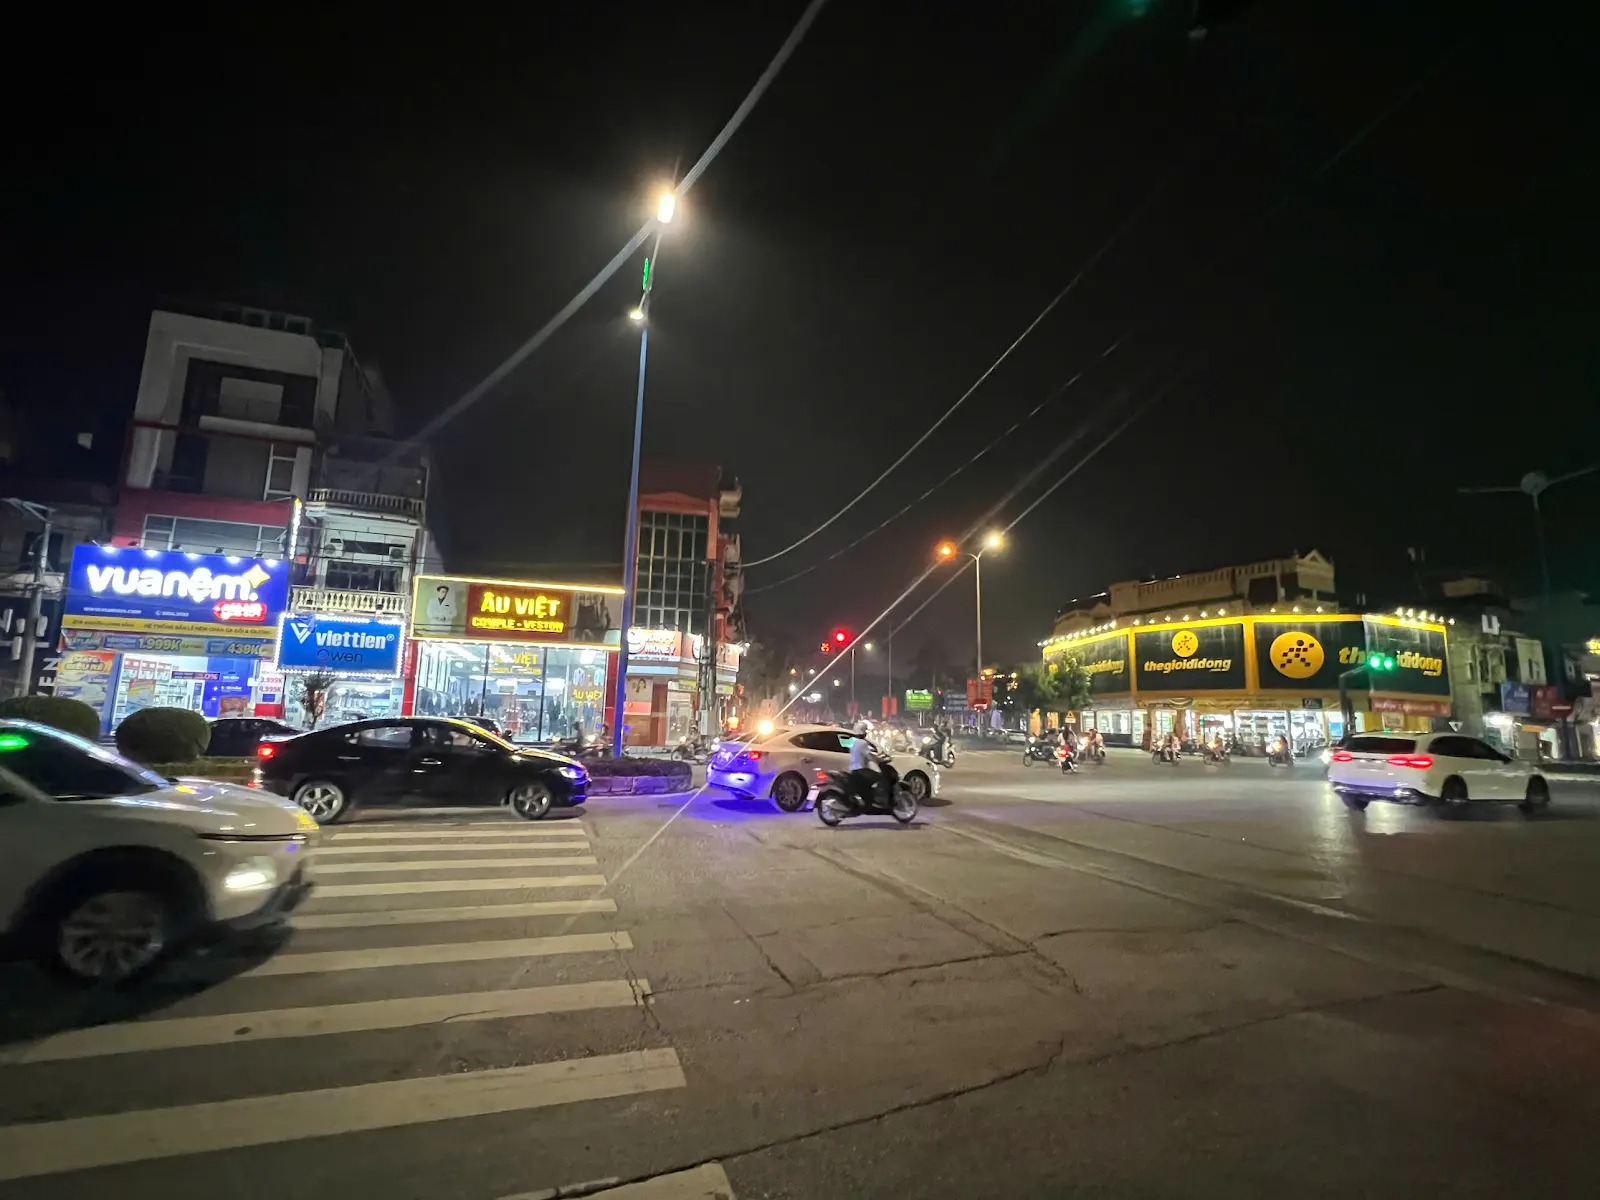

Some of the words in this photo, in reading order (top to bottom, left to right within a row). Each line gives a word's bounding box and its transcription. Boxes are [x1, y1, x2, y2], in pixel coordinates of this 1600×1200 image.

[481, 592, 511, 613] ÂU
[514, 596, 561, 618] VIỆT
[317, 649, 363, 664] Owen
[1144, 658, 1232, 674] thegioididong
